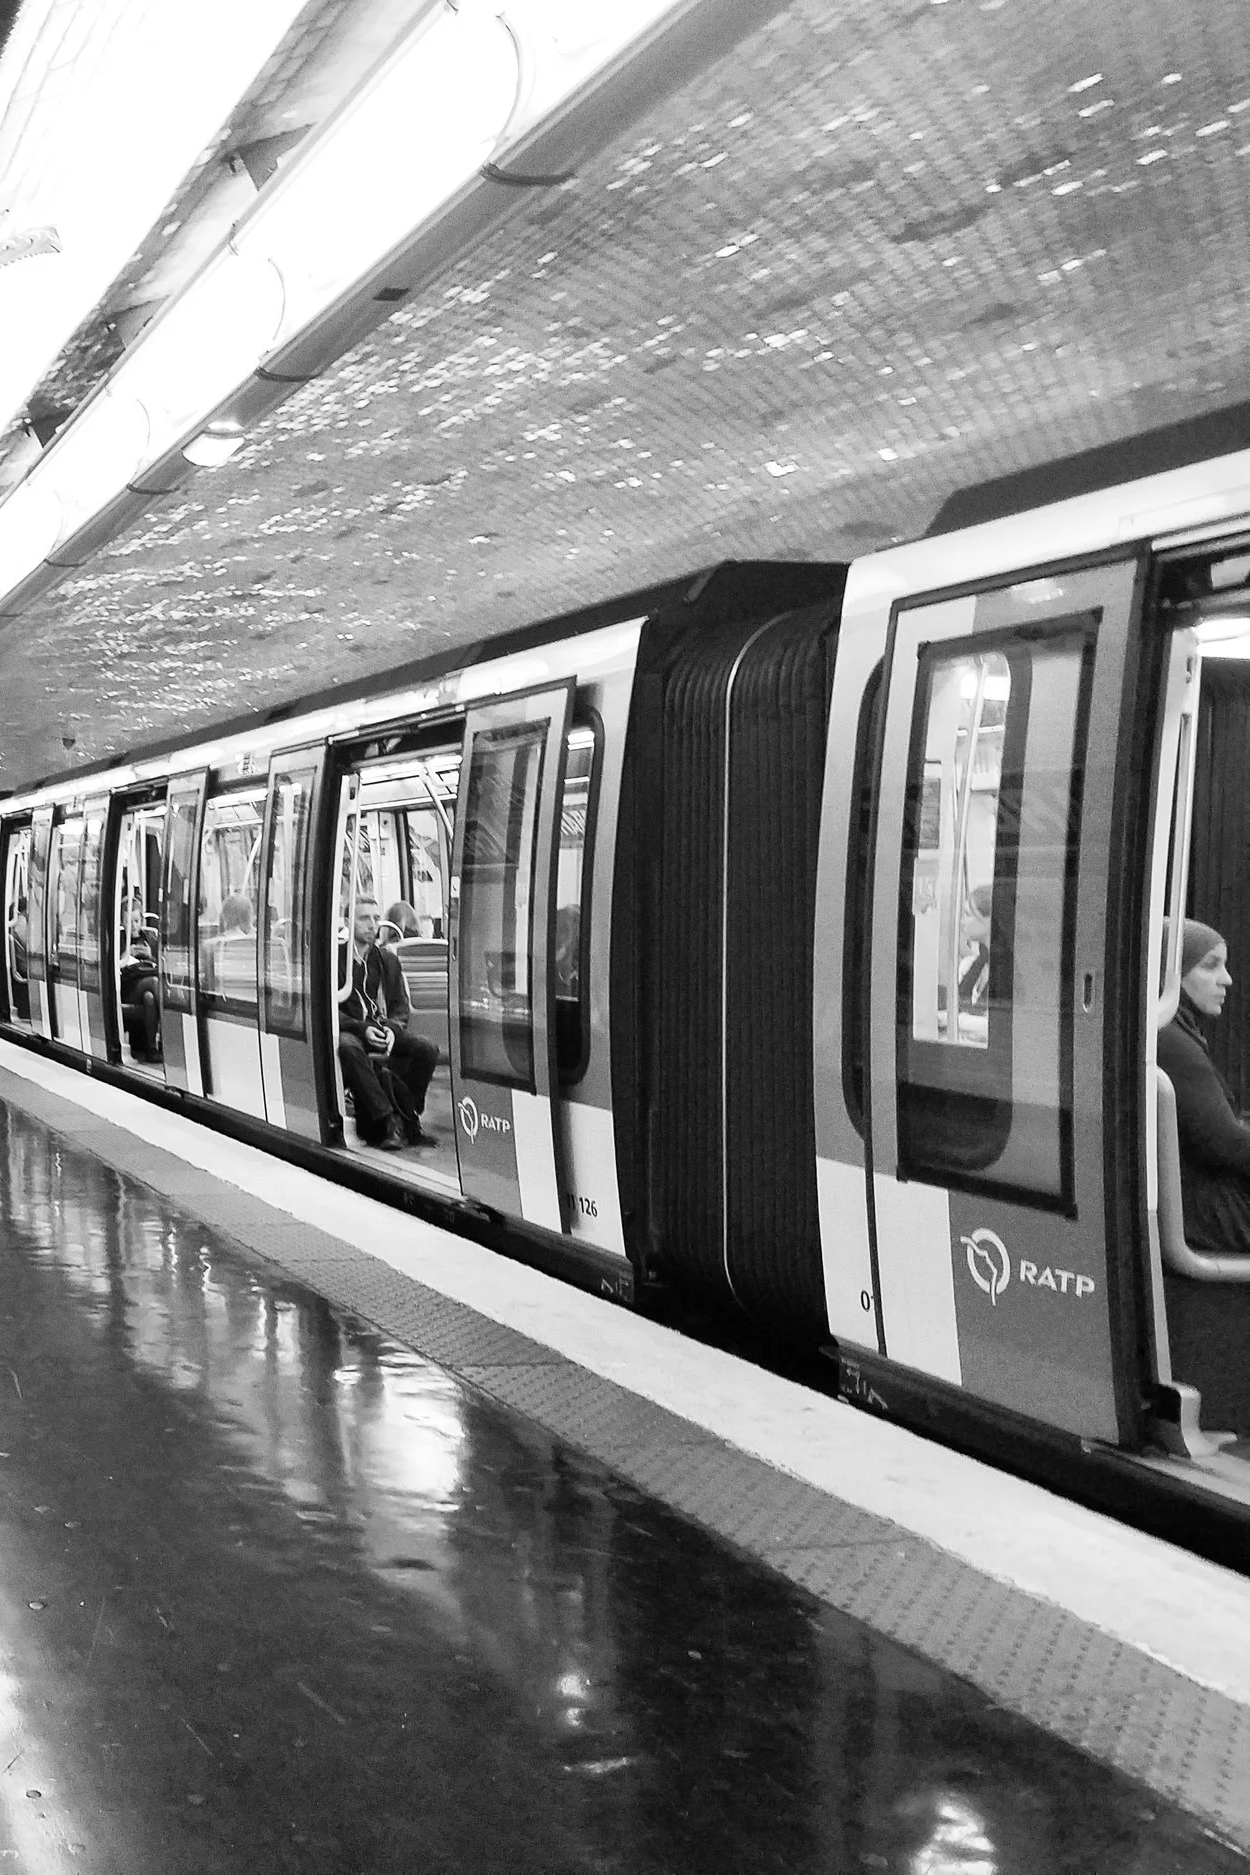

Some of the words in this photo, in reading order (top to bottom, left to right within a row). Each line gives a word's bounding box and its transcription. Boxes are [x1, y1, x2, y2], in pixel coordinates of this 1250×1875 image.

[480, 1114, 511, 1134] RATP
[579, 1196, 598, 1218] 126
[1019, 1258, 1095, 1299] RATP
